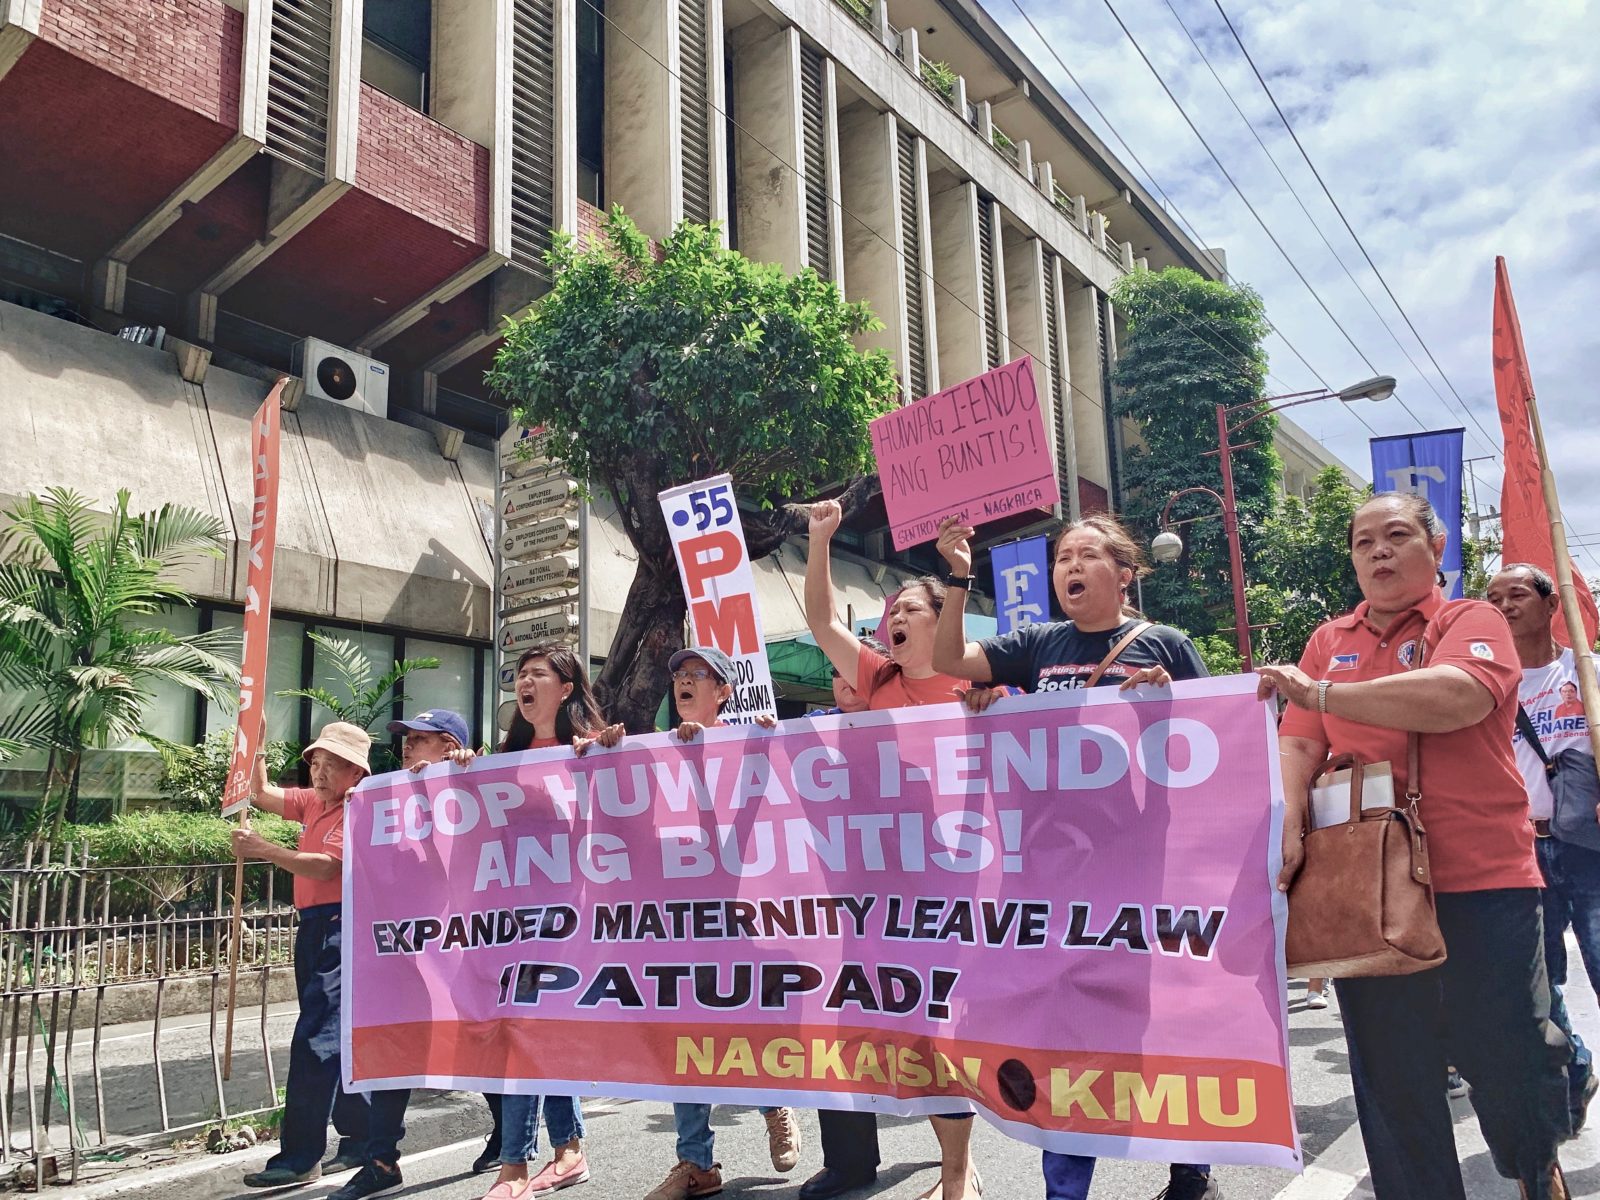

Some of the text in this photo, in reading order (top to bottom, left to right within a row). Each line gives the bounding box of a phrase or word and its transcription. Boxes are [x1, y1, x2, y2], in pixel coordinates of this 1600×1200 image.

[877, 360, 1037, 456] HUWAG I-ENDO
[890, 418, 1038, 500] ANG BUNTIS!
[529, 565, 551, 576] NATIONAL
[514, 633, 533, 642] NATIONAL
[533, 629, 550, 639] CAPITAL
[531, 621, 548, 632] DOLE
[1040, 666, 1076, 677] Fighting
[1104, 663, 1126, 674] with
[369, 717, 1220, 847] ECOP HUWAG I-ENDO
[473, 808, 1024, 892] ANG BUNTIS!
[373, 895, 1227, 961] EXPANDED MATERNITY LEAVE LAW
[1049, 1066, 1257, 1128] KMU
